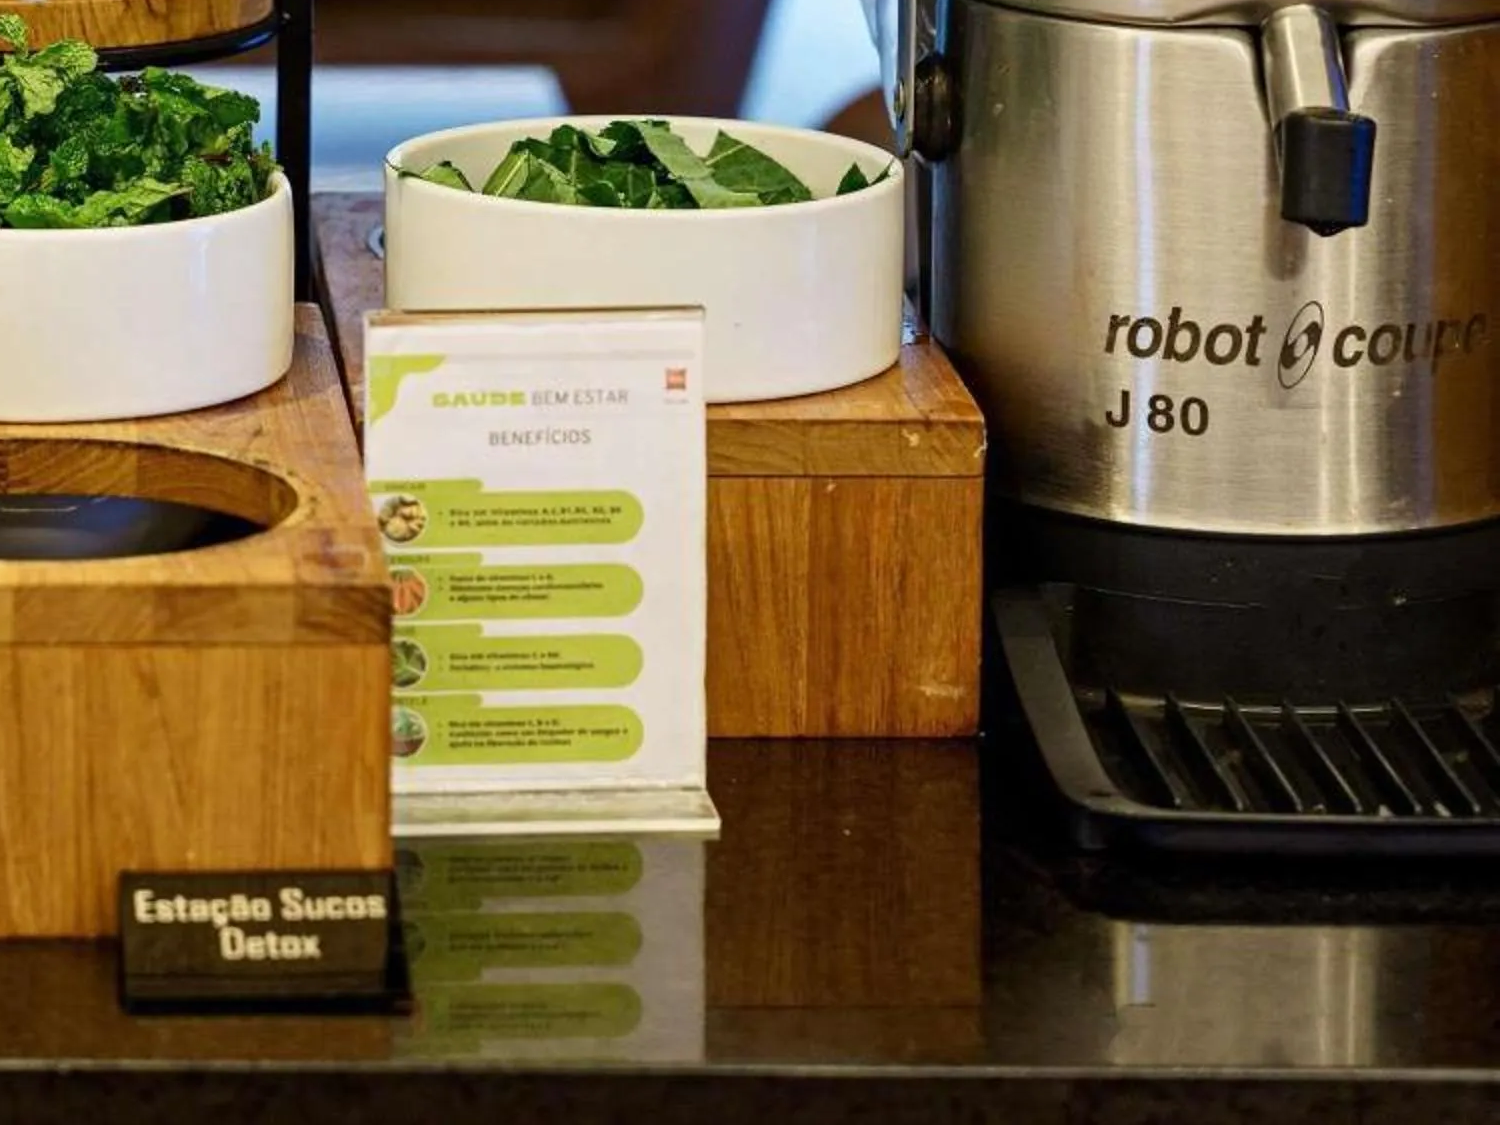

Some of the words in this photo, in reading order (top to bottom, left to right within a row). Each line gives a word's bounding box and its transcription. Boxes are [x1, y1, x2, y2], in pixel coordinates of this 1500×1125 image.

[1104, 306, 1268, 368] robot
[1105, 389, 1131, 428] J
[1146, 393, 1210, 436] 80
[488, 425, 592, 446] BENEFÍCIOS
[133, 888, 273, 928] Estação
[278, 886, 387, 921] Sucos
[218, 925, 322, 960] Detox
